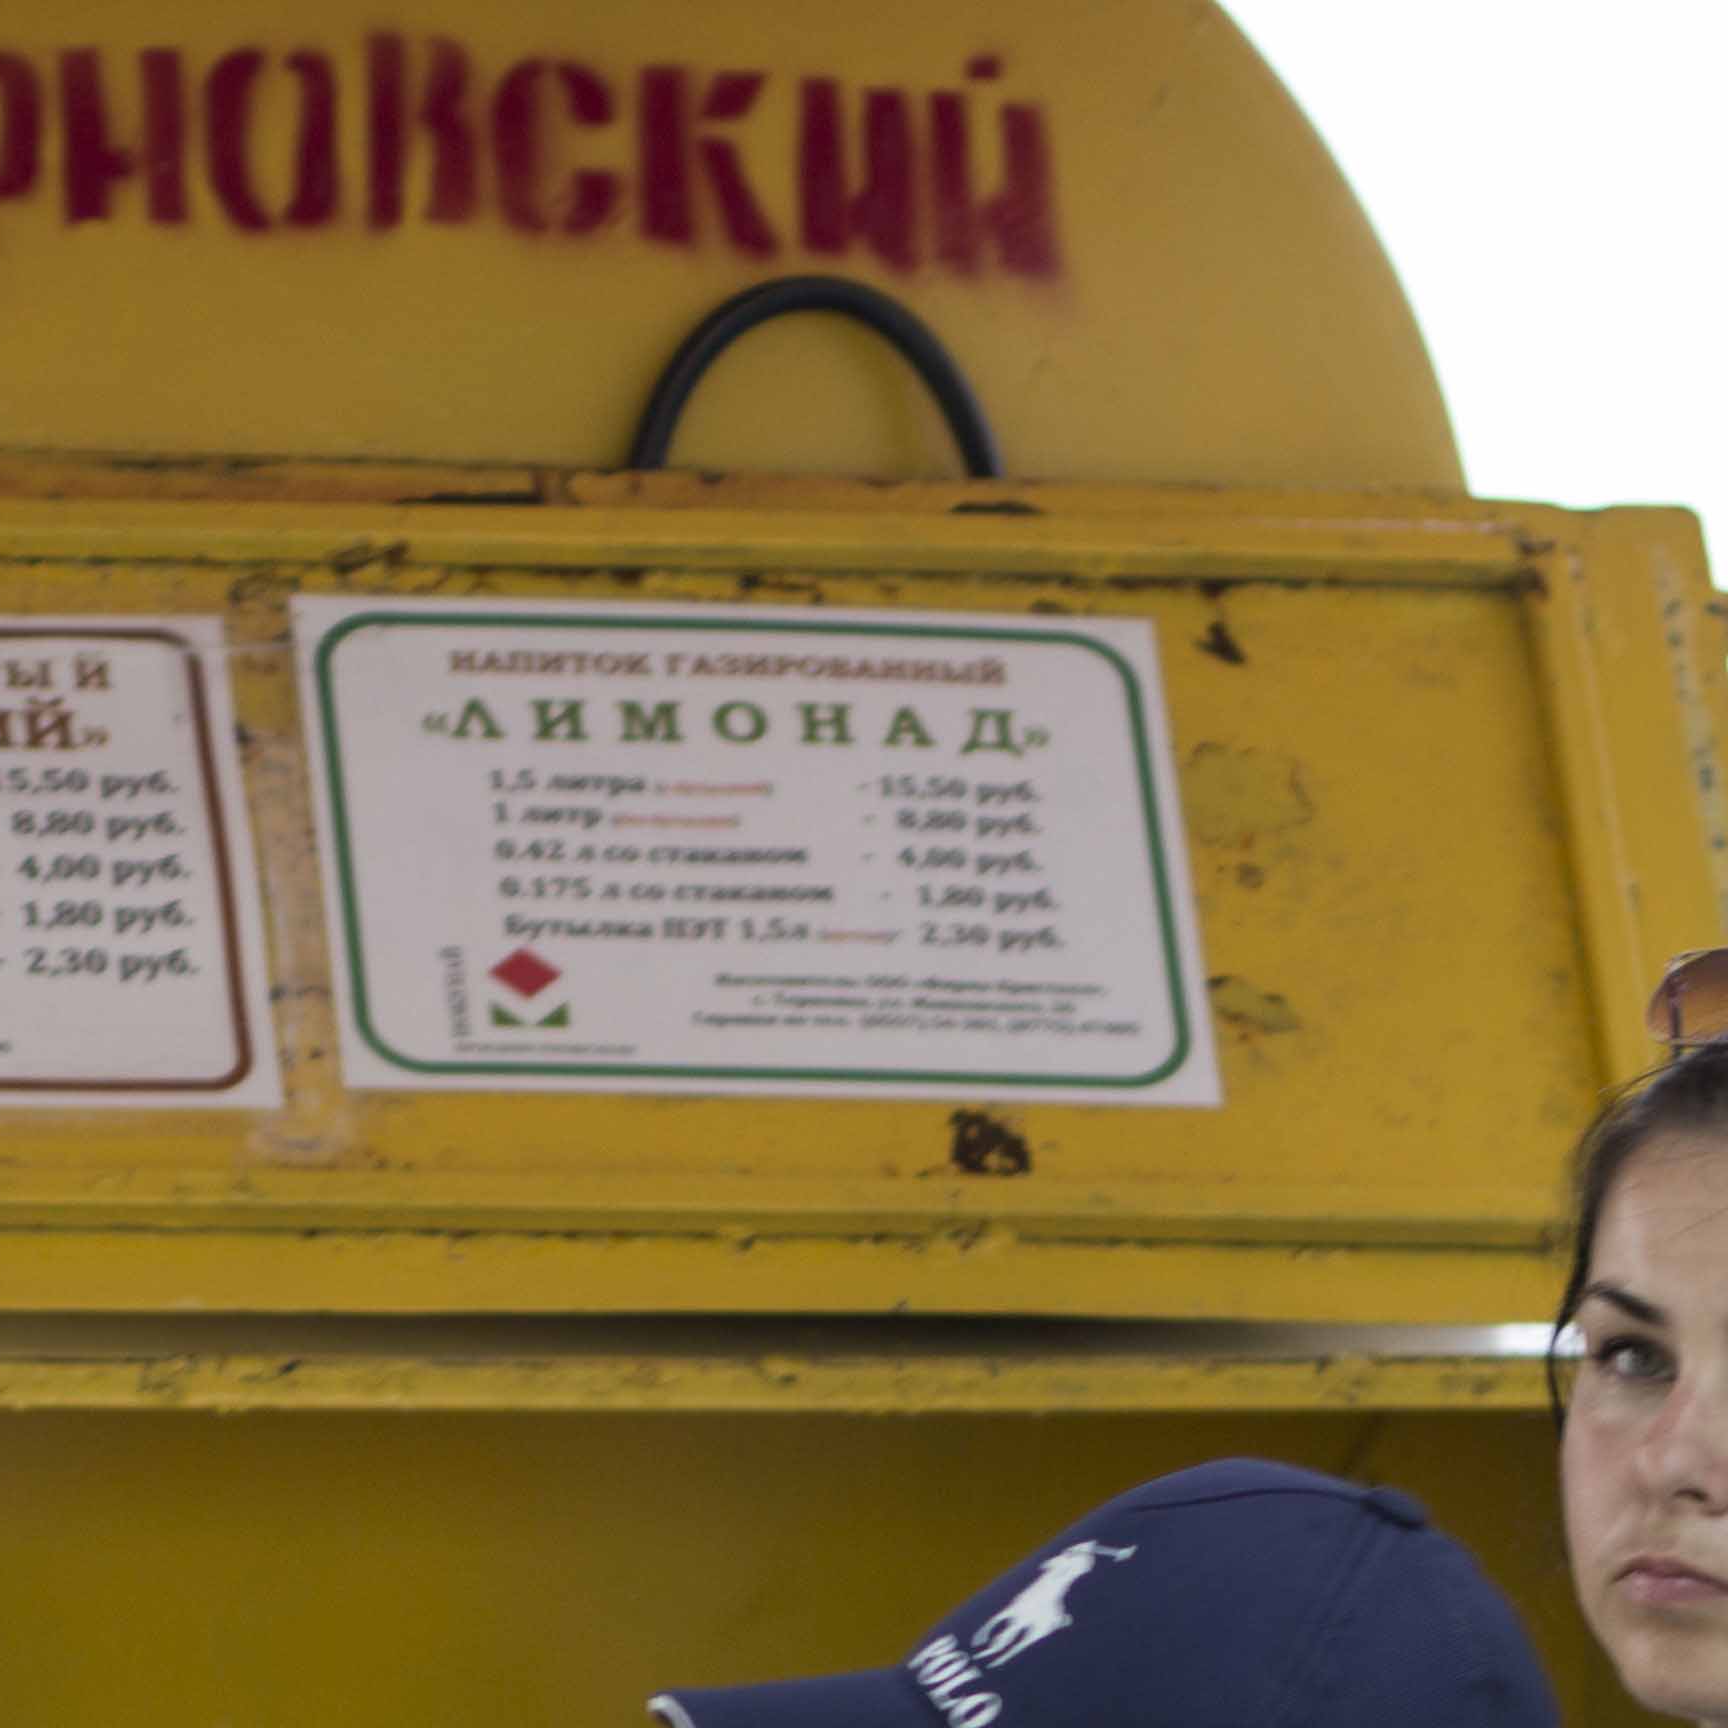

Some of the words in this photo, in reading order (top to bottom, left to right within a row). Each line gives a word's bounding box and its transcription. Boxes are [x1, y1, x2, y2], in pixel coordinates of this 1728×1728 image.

[449, 650, 652, 677] НАПИТОК
[666, 653, 1008, 687] ГАЗИРОВАННЫЙ
[421, 696, 1050, 756] «ЛИМОНАД»
[99, 769, 181, 800] руб.
[546, 773, 646, 797] литра
[976, 780, 1041, 806] руб.
[106, 810, 186, 842] руб.
[521, 806, 603, 829] литр
[976, 812, 1042, 838] руб.
[112, 853, 192, 887] руб.
[647, 846, 807, 866] стаканом
[976, 849, 1042, 876] руб.
[672, 884, 834, 905] стаканом
[994, 885, 1061, 914] руб.
[115, 898, 195, 935] руб.
[503, 914, 654, 941] Бутылка
[998, 925, 1066, 952] руб.
[119, 947, 200, 984] руб.
